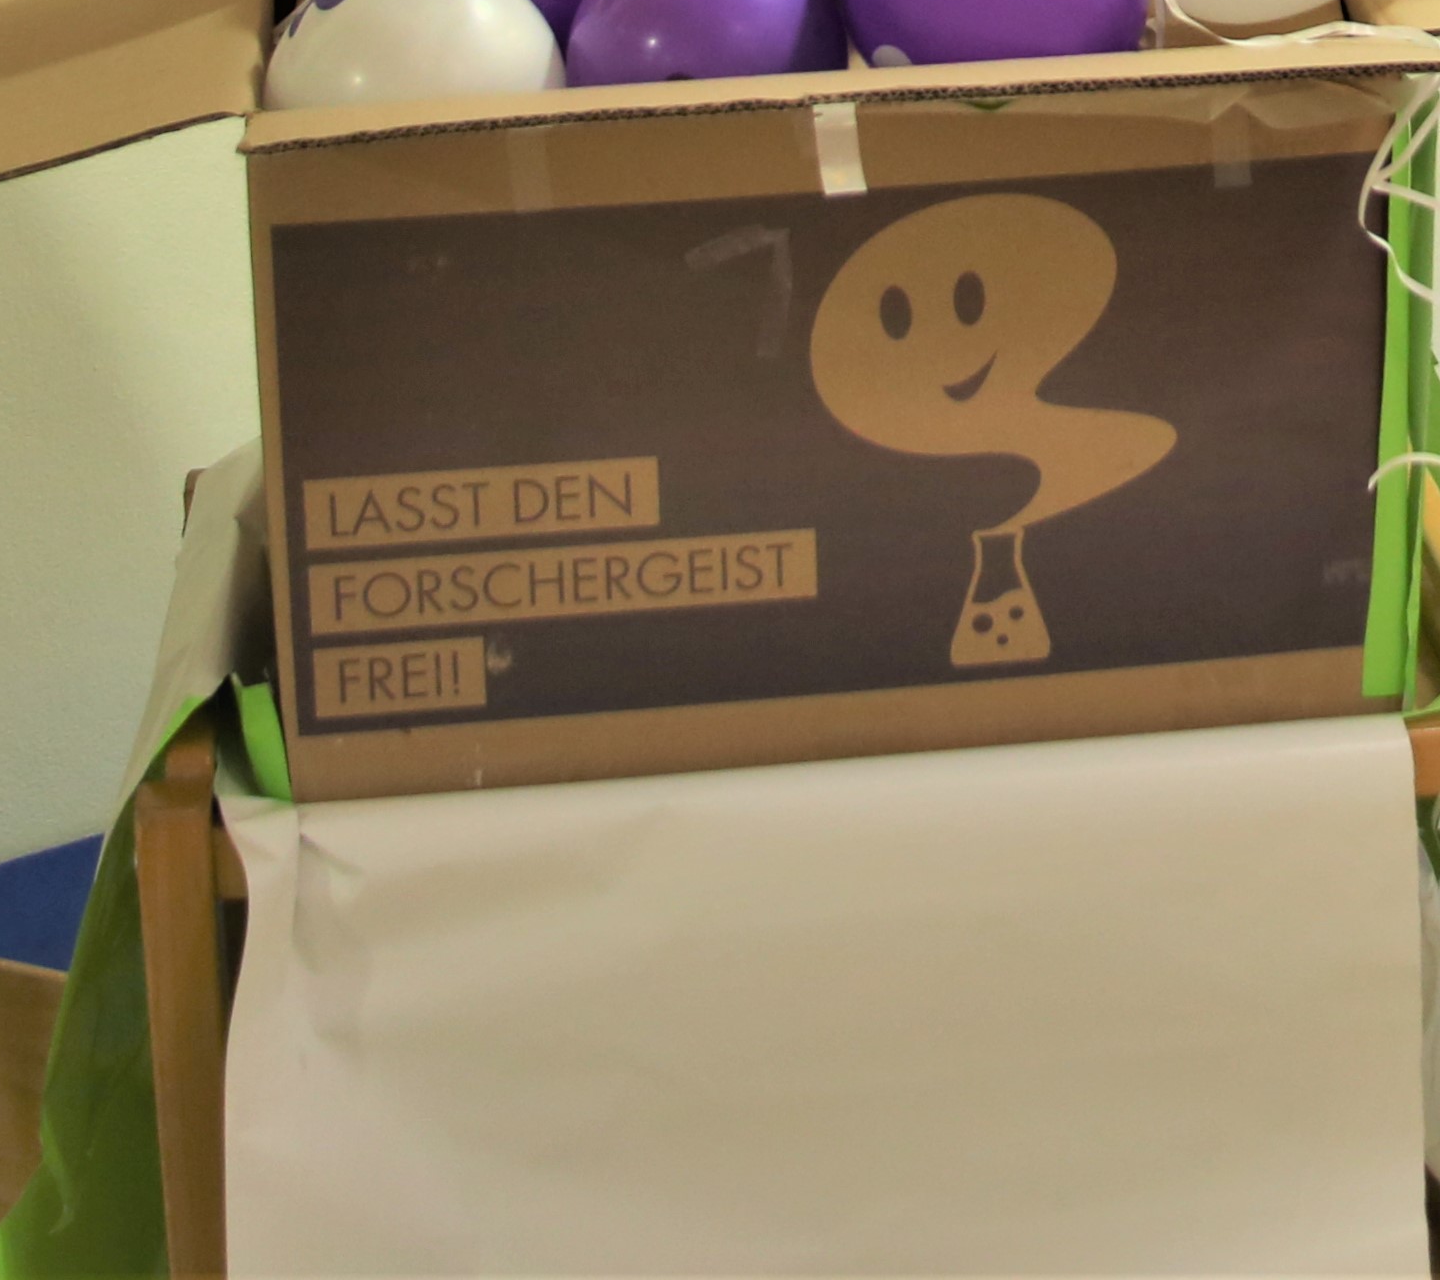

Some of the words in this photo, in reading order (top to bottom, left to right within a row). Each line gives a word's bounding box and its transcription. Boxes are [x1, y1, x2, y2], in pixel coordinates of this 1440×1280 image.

[325, 479, 493, 538] LASST
[511, 472, 634, 524] DEN
[331, 542, 796, 624] FORSCHERGEIST
[337, 651, 464, 706] FREI!
